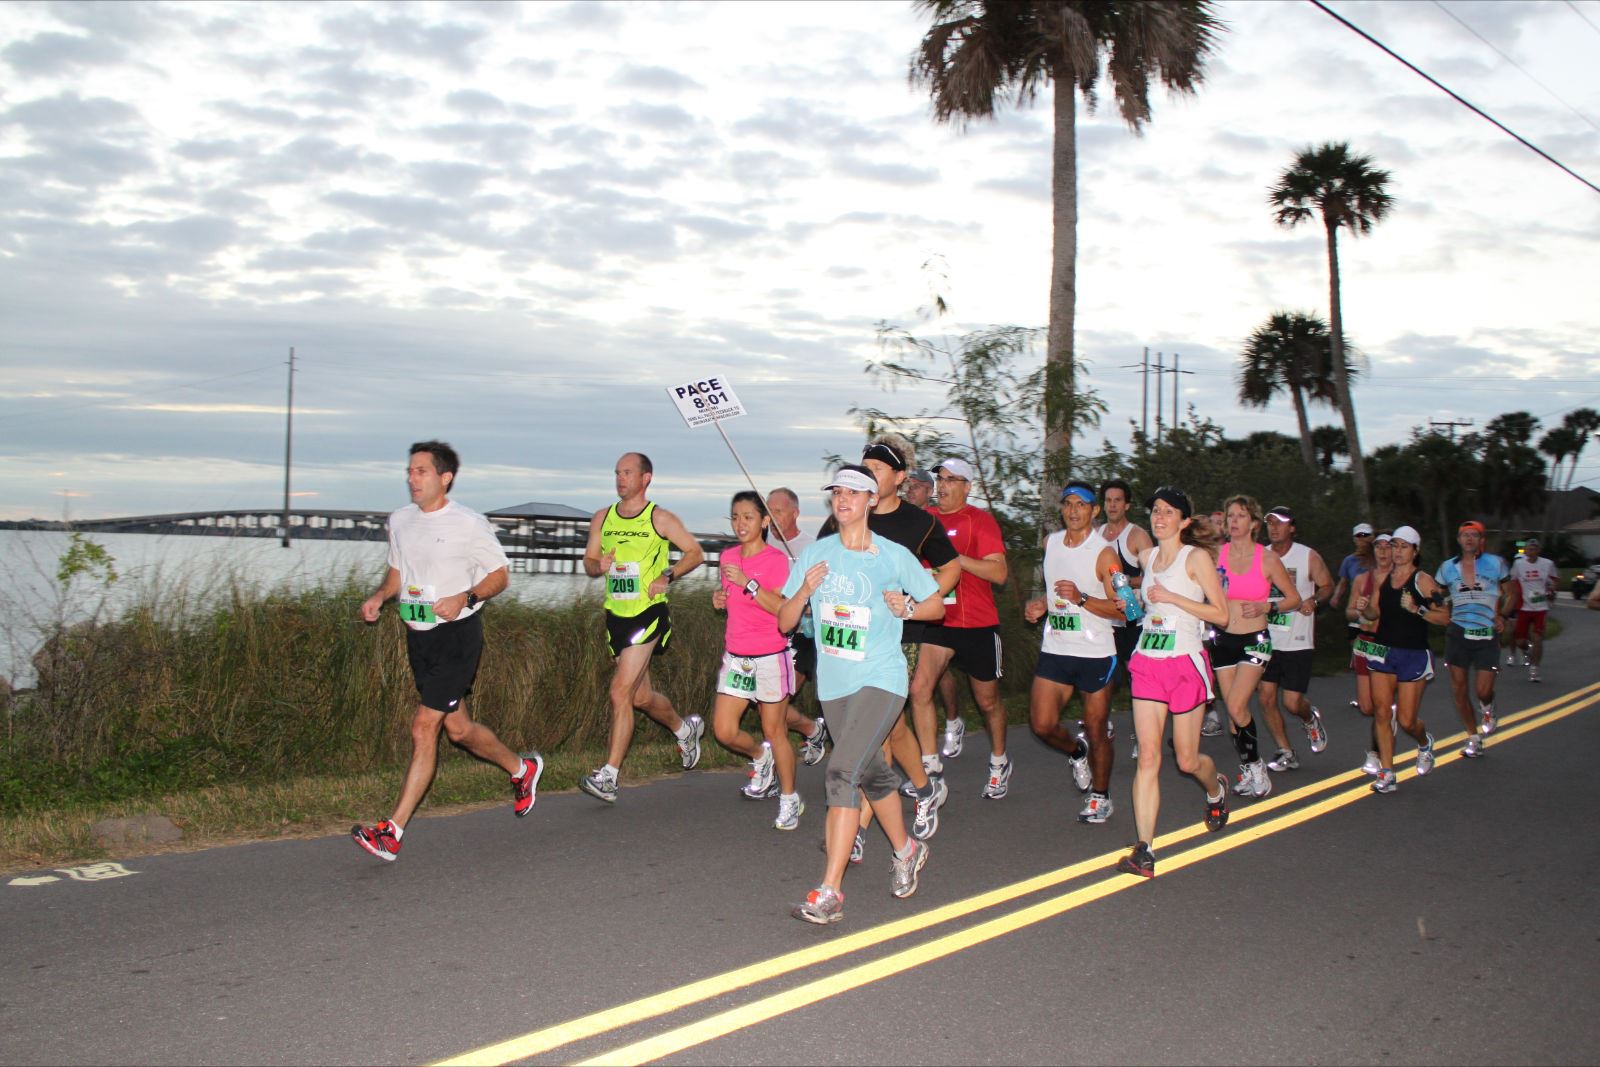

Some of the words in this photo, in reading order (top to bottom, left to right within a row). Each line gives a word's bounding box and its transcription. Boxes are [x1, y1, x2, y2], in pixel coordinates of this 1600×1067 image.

[675, 379, 722, 399] PACE
[693, 391, 729, 409] 8:01
[603, 530, 651, 538] BROOKS
[612, 578, 635, 593] 209
[409, 604, 427, 622] 14
[1051, 615, 1076, 631] 384
[825, 626, 858, 650] 414
[1143, 632, 1170, 650] 727
